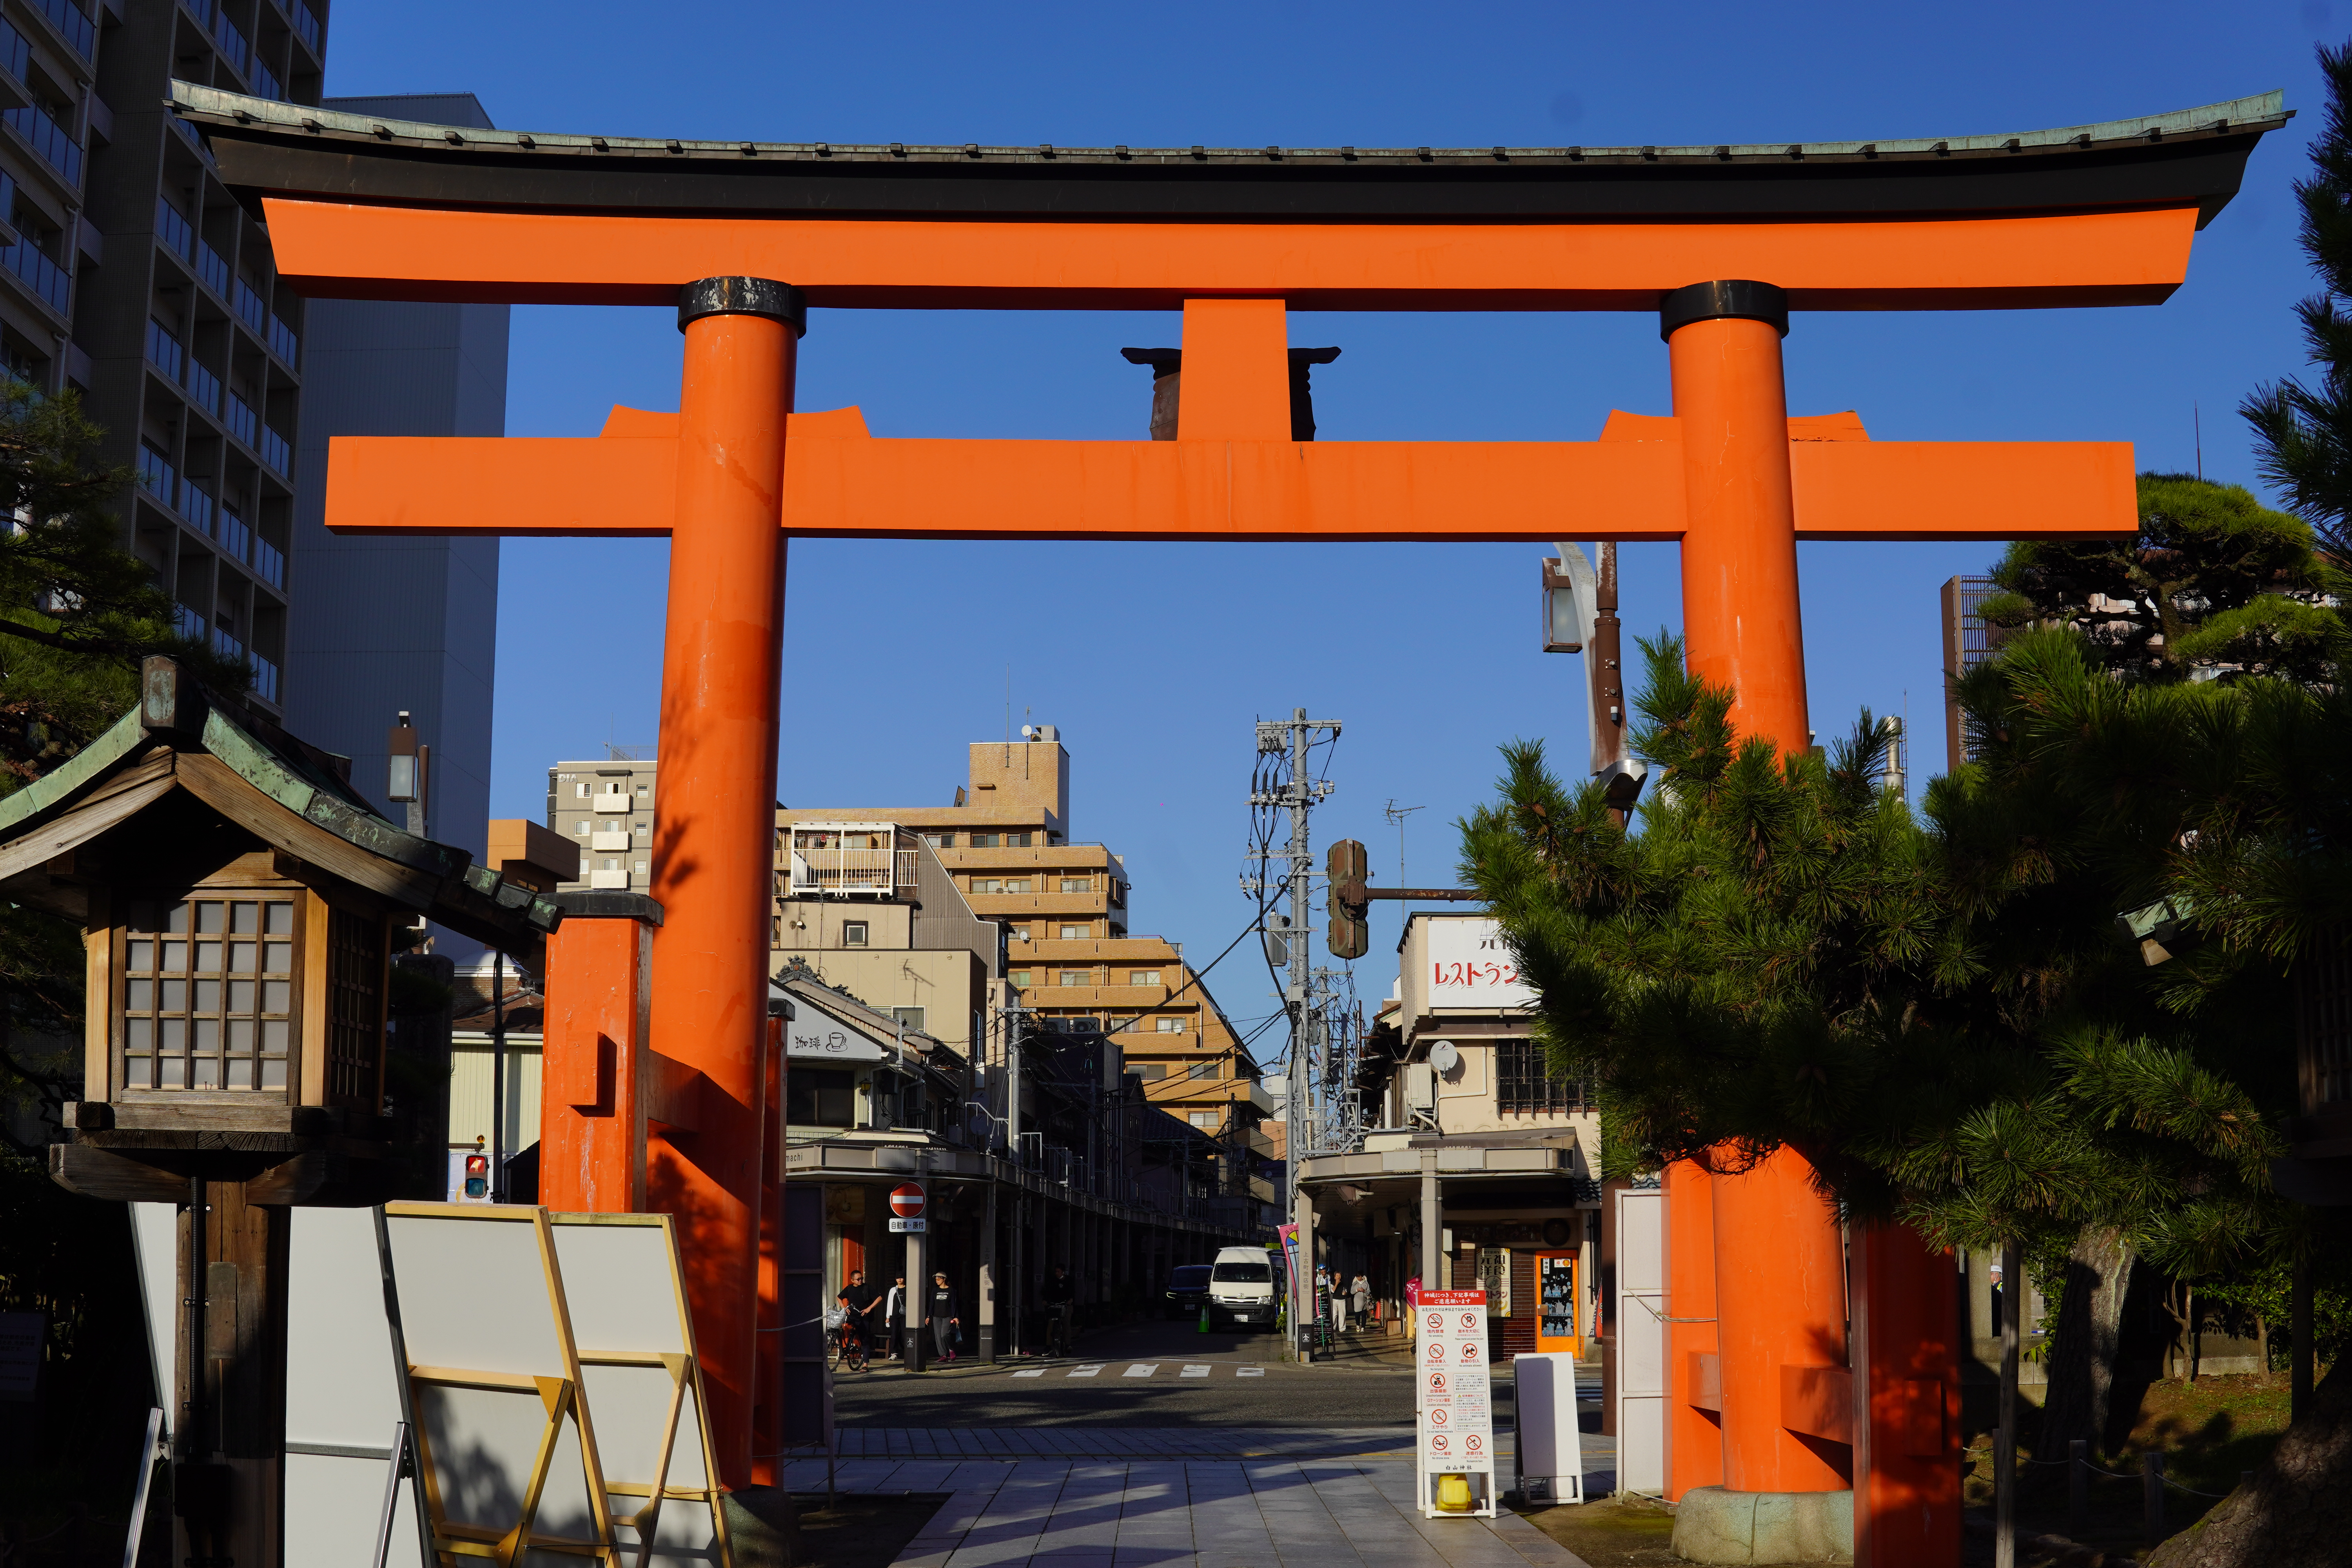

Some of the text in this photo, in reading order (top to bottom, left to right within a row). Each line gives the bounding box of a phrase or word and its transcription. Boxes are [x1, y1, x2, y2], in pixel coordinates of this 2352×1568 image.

[559, 774, 578, 782] DIA
[1435, 962, 1519, 986] レストラン
[795, 1035, 821, 1051] 珈琲
[891, 1221, 924, 1229] 自動車・原付
[1480, 1254, 1506, 1264] 元祖
[1480, 1265, 1506, 1275] 洋食
